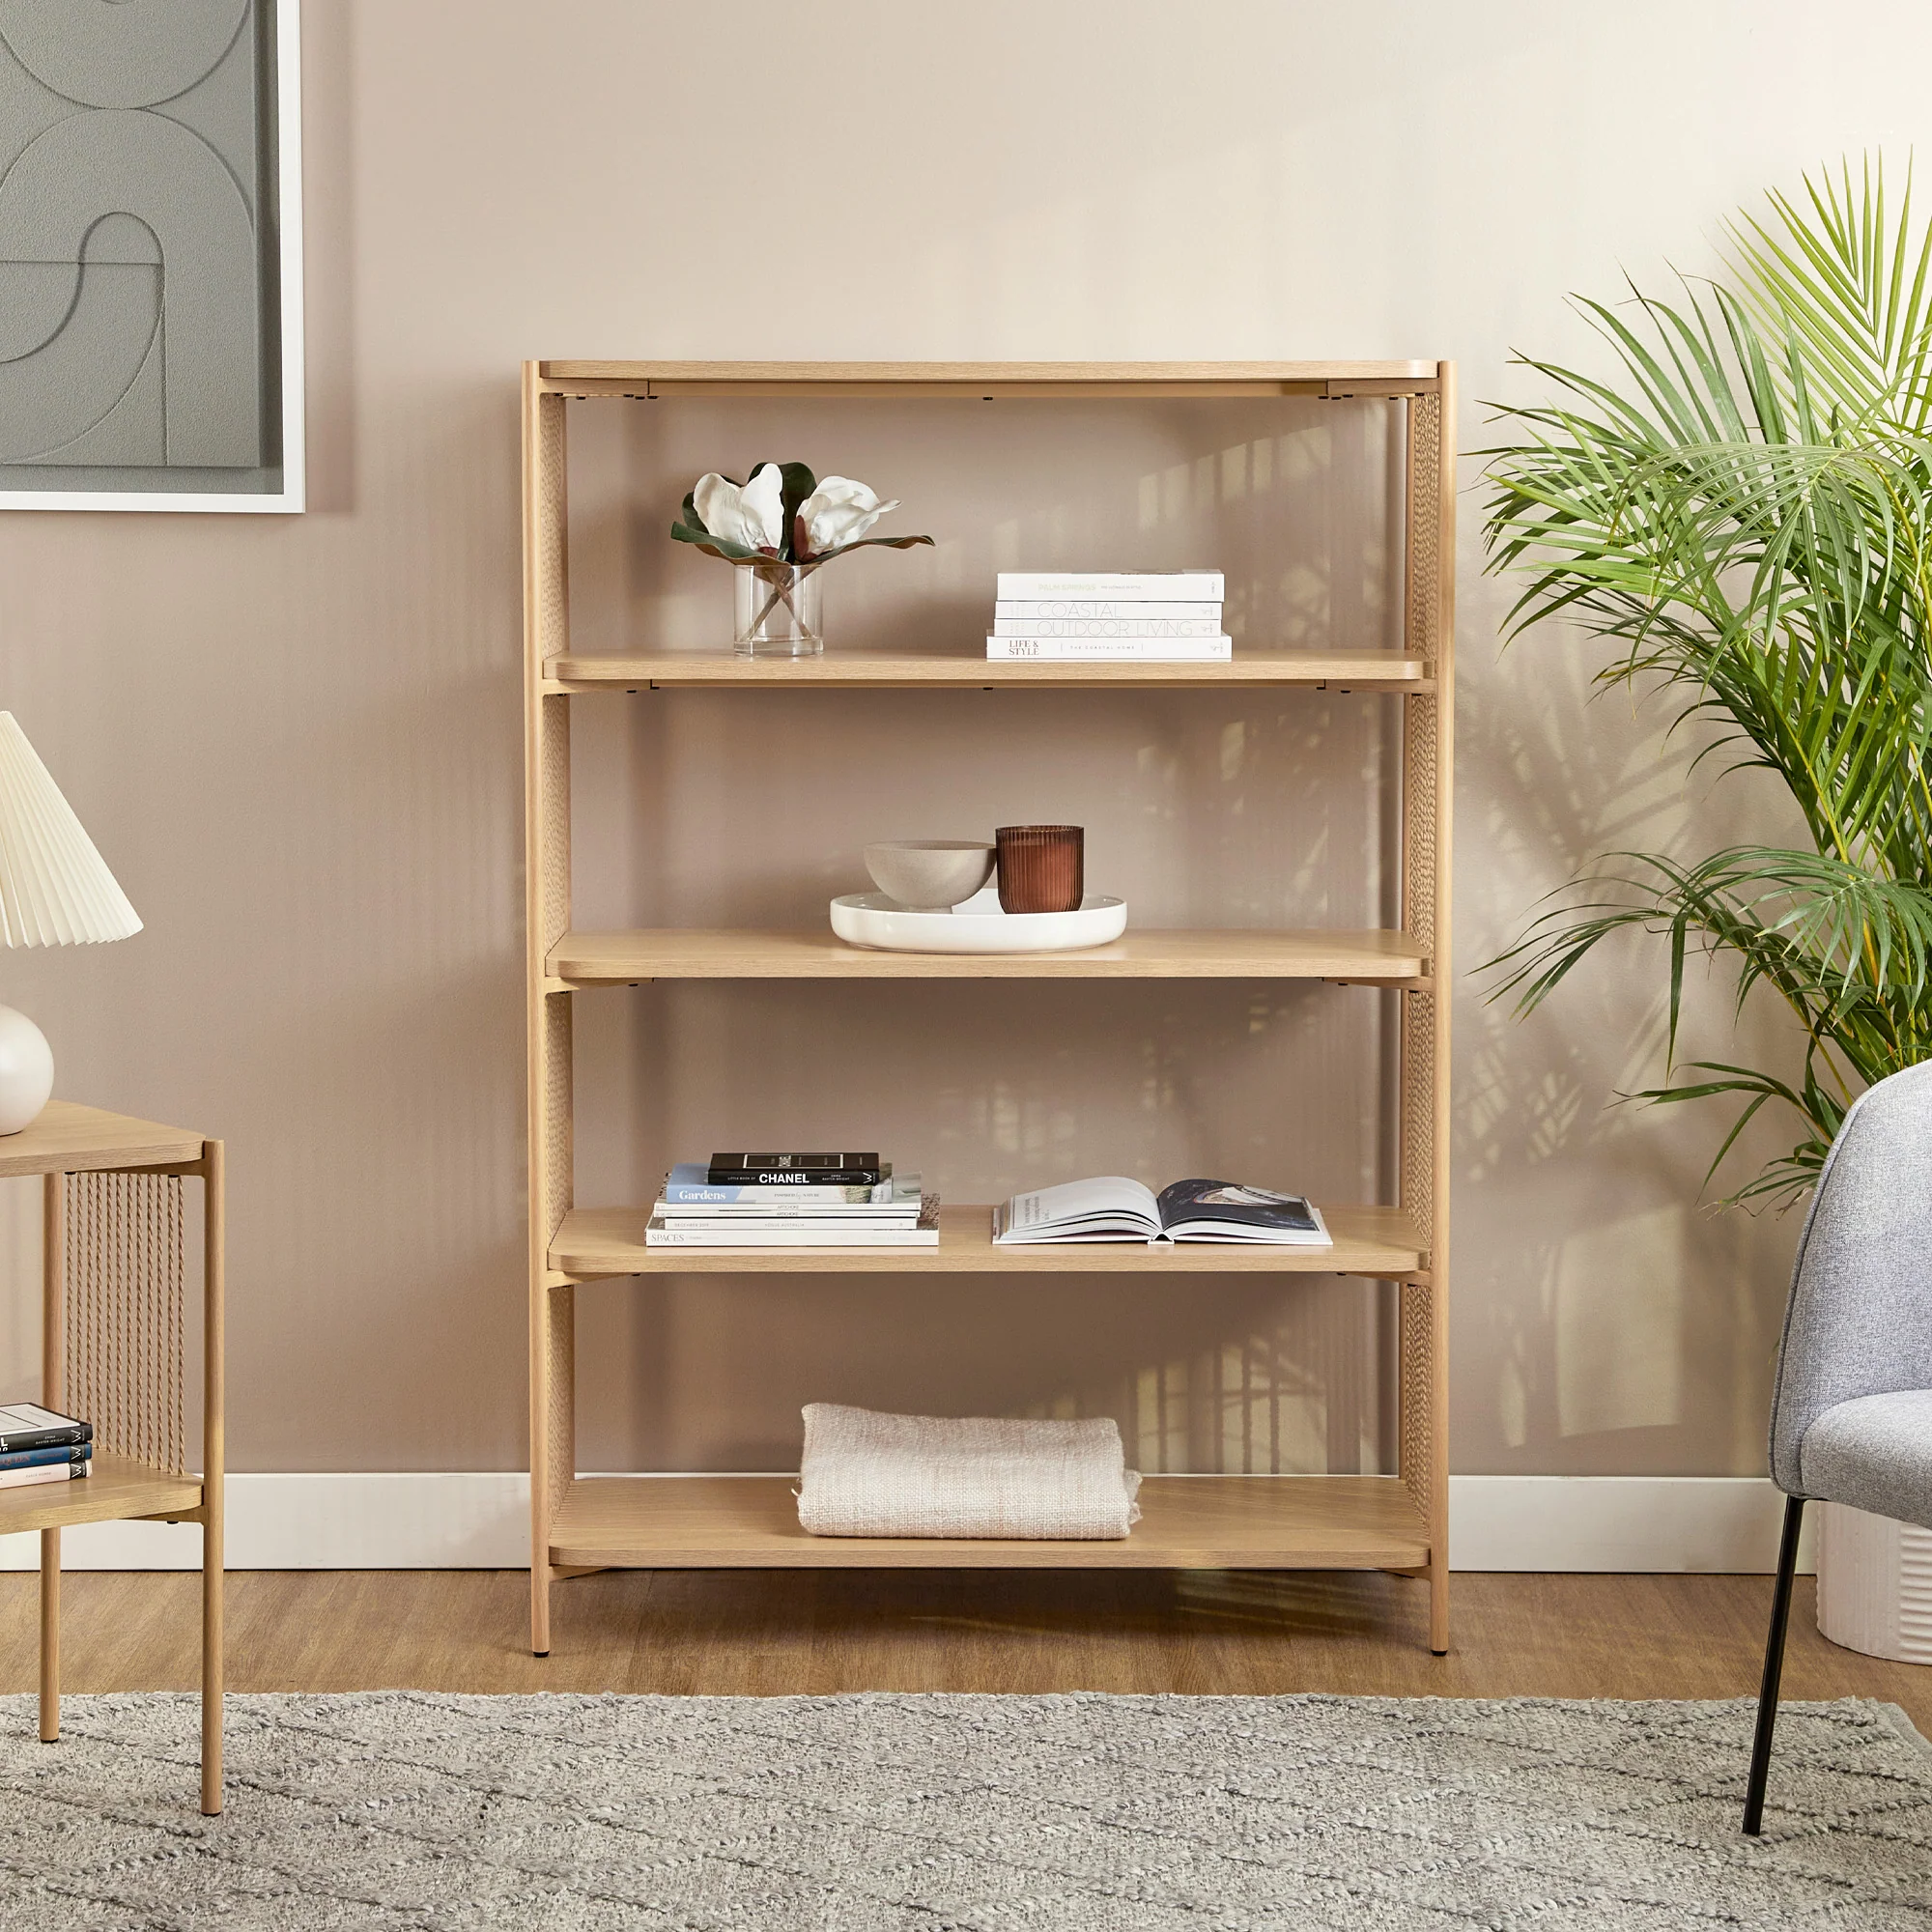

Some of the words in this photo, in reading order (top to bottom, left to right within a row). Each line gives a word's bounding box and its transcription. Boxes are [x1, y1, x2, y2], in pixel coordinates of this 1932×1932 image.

[1037, 603, 1122, 617] COASTAL
[1037, 621, 1129, 636] OUTDOOR
[1136, 621, 1193, 636] LIVING
[1009, 639, 1031, 648] LIFE
[1033, 639, 1039, 648] &
[1009, 647, 1039, 656] STYLE
[758, 1174, 810, 1183] CHANEL
[679, 1190, 726, 1201] Gardens
[651, 1234, 685, 1242] SPACES
